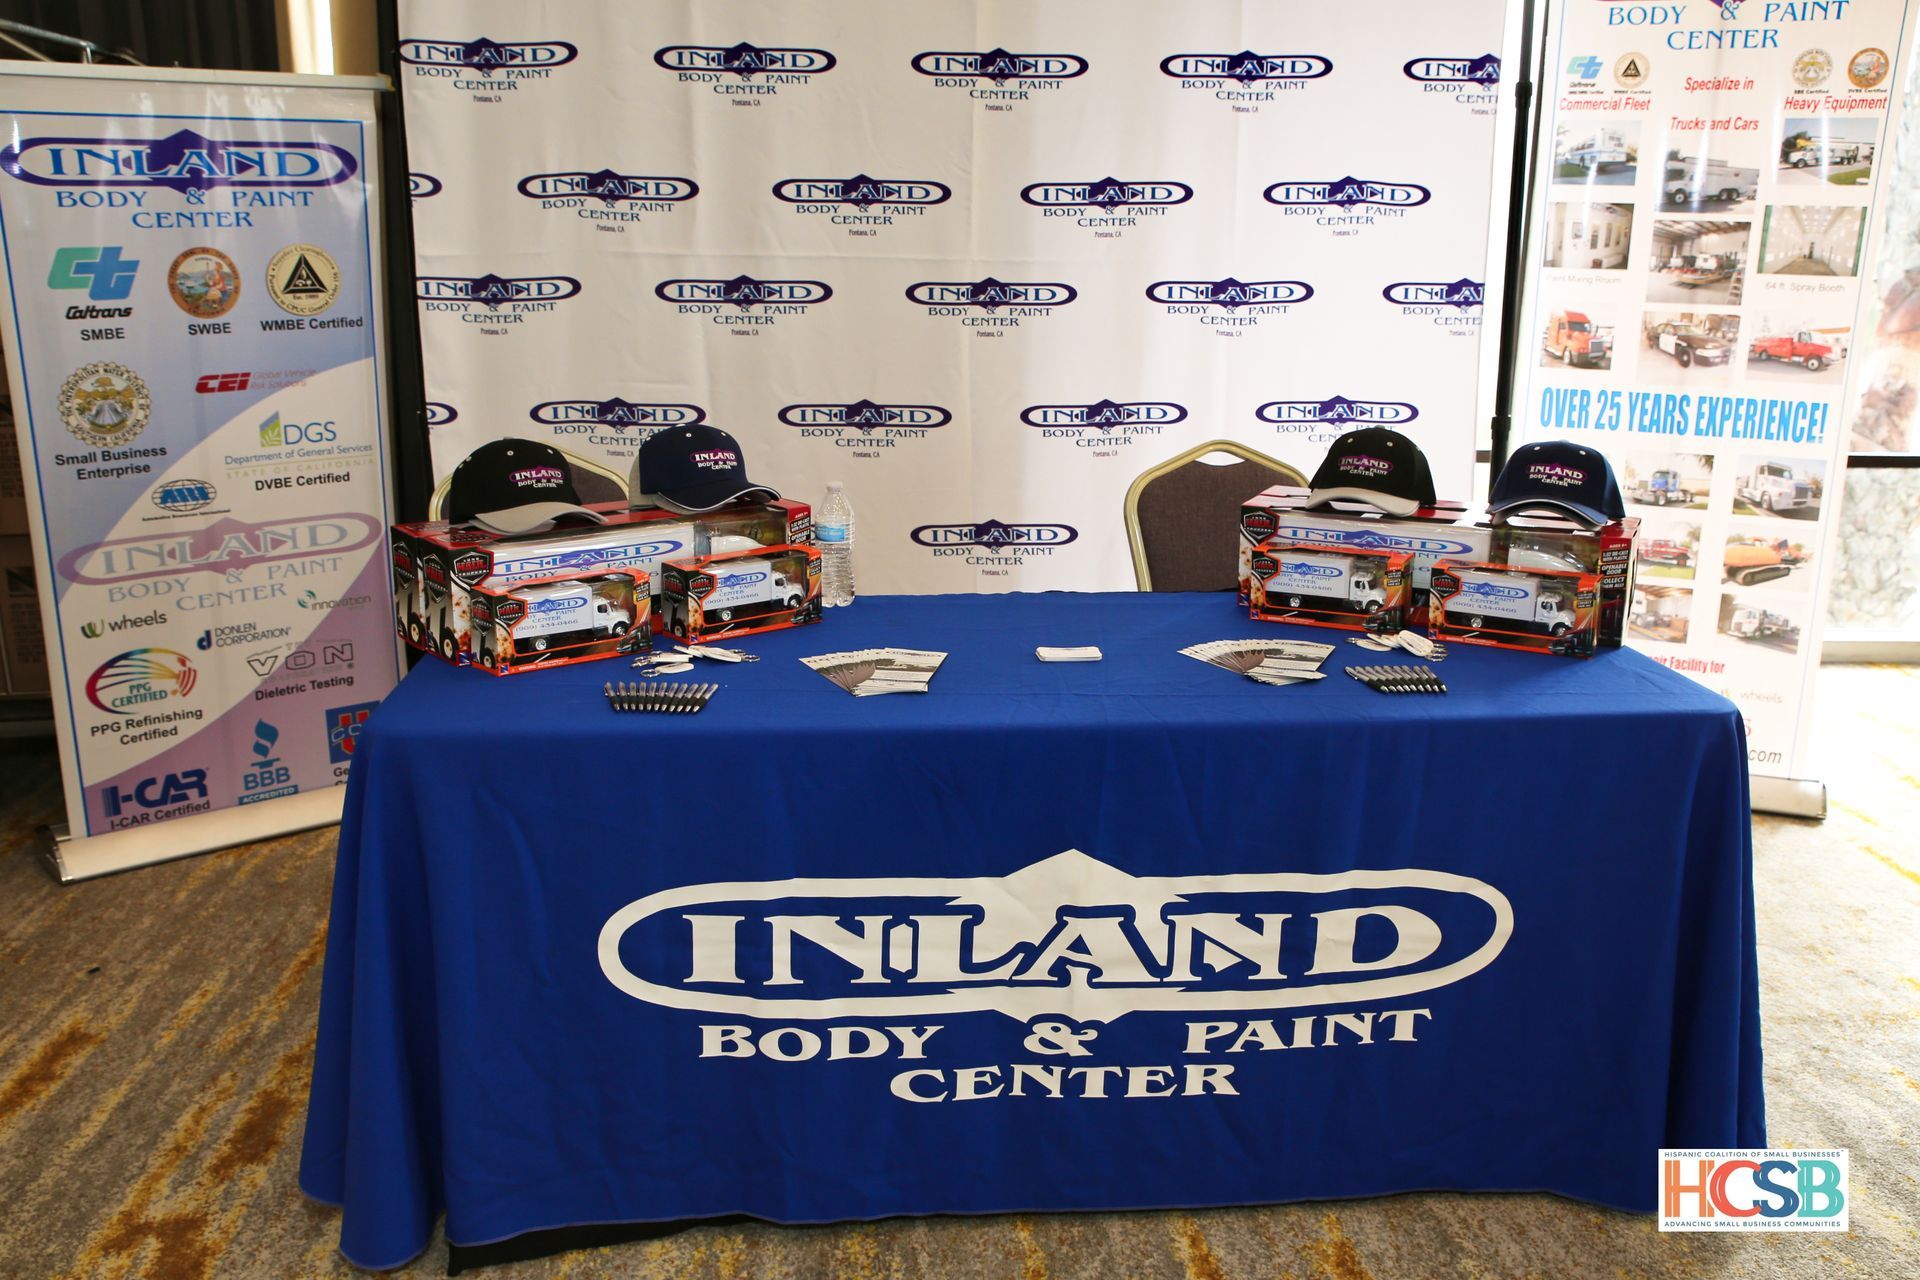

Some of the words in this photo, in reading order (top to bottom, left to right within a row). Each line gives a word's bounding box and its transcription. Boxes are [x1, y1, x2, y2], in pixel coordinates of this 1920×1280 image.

[1608, 6, 1686, 26] BODY
[1720, 1, 1738, 21] &
[1764, 0, 1852, 22] PAINT
[1667, 29, 1779, 50] CENTER
[676, 51, 815, 69] INLAND
[678, 72, 722, 82] BODY
[741, 72, 753, 82] &
[765, 74, 811, 84] PAINT
[1684, 76, 1740, 91] Specialize
[1743, 76, 1754, 90] in
[713, 84, 777, 94] CENTER
[1559, 96, 1622, 111] Commercial
[1624, 97, 1652, 111] Fleet
[1784, 96, 1821, 113] Heavy
[1823, 95, 1888, 113] Equipment
[1671, 117, 1706, 131] Trucks
[1710, 118, 1731, 130] and
[1733, 117, 1759, 131] Cars
[48, 147, 321, 178] INLAND
[56, 190, 147, 208] BODY
[186, 188, 205, 206] &
[232, 190, 314, 208] PAINT
[794, 184, 931, 200] INLAND
[1284, 185, 1412, 202] INLAND
[796, 204, 841, 214] BODY
[858, 203, 869, 213] &
[882, 205, 927, 215] PAINT
[1284, 206, 1326, 216] BODY
[1343, 204, 1353, 213] &
[1365, 206, 1407, 218] PAINT
[132, 211, 254, 229] CENTER
[831, 215, 893, 225] CENTER
[1316, 216, 1375, 226] CENTER
[422, 281, 561, 298] INLAND
[927, 286, 1057, 302] INLAND
[1789, 282, 1816, 294] Spray
[1818, 283, 1845, 293] Booth
[65, 305, 133, 320] Caltrans
[425, 302, 471, 312] BODY
[489, 302, 499, 312] &
[512, 302, 557, 312] PAINT
[928, 307, 971, 316] BODY
[986, 306, 997, 315] &
[1009, 307, 1053, 316] PAINT
[260, 319, 305, 331] WMBE
[309, 316, 363, 329] Certified
[462, 314, 524, 324] CENTER
[961, 317, 1020, 327] CENTER
[80, 328, 125, 341] SMBE
[188, 322, 231, 335] SWBE
[103, 368, 124, 377] WATER
[196, 372, 251, 394] CEI
[1540, 387, 1591, 429] OVER
[1594, 390, 1622, 431] 25
[1628, 392, 1690, 436] YEARS
[1694, 395, 1829, 444] EXPERIENCE!
[283, 421, 337, 445] DGS
[55, 452, 97, 466] Small
[101, 447, 167, 462] Business
[224, 453, 282, 466] Department
[285, 450, 295, 459] of
[297, 447, 334, 457] General
[337, 444, 373, 454] Services
[694, 452, 735, 461] INLAND
[226, 469, 265, 480] STATE
[273, 466, 289, 474] OF
[297, 458, 374, 473] CALIFORNIA
[1341, 458, 1389, 469] INLAND
[77, 464, 151, 480] Enterprise
[515, 469, 562, 480] INLAND
[1349, 469, 1374, 477] CENTER
[1529, 465, 1583, 479] INLAND
[255, 478, 293, 491] DVBE
[296, 472, 350, 487] Certified
[517, 479, 537, 487] BODY
[1541, 478, 1568, 487] CENTER
[931, 528, 1059, 543] INLAND
[1291, 529, 1447, 551] INLAND
[101, 523, 349, 576] INLAND
[933, 547, 974, 557] BODY
[990, 546, 1001, 555] &
[1013, 547, 1055, 556] PAINT
[504, 543, 660, 573] INLAND
[607, 558, 653, 569] PAINT
[965, 556, 1024, 566] CENTER
[108, 577, 191, 603] BODY
[225, 568, 245, 584] &
[267, 557, 342, 581] PAINT
[176, 583, 287, 611] CENTER
[311, 595, 372, 611] innovation
[108, 610, 168, 633] wheels
[215, 622, 257, 638] DONLEN
[1670, 656, 1708, 674] Facility
[1710, 660, 1726, 674] for
[129, 682, 152, 694] PPG
[255, 683, 306, 701] Dieletric
[309, 675, 354, 692] Testing
[111, 690, 168, 708] CERTIFIED
[1740, 691, 1782, 703] wheels
[91, 722, 121, 736] PPG
[125, 709, 203, 730] Refinishing
[120, 726, 178, 745] Certified
[243, 767, 291, 791] BBB
[242, 787, 295, 803] ACCREDITED
[110, 812, 150, 830] I-CAR
[154, 799, 210, 821] Certified
[681, 905, 1443, 987] INLAND
[699, 1023, 945, 1063] BODY
[1023, 1020, 1102, 1058] &
[1183, 1008, 1433, 1055] PAINT
[890, 1063, 1240, 1104] CENTER
